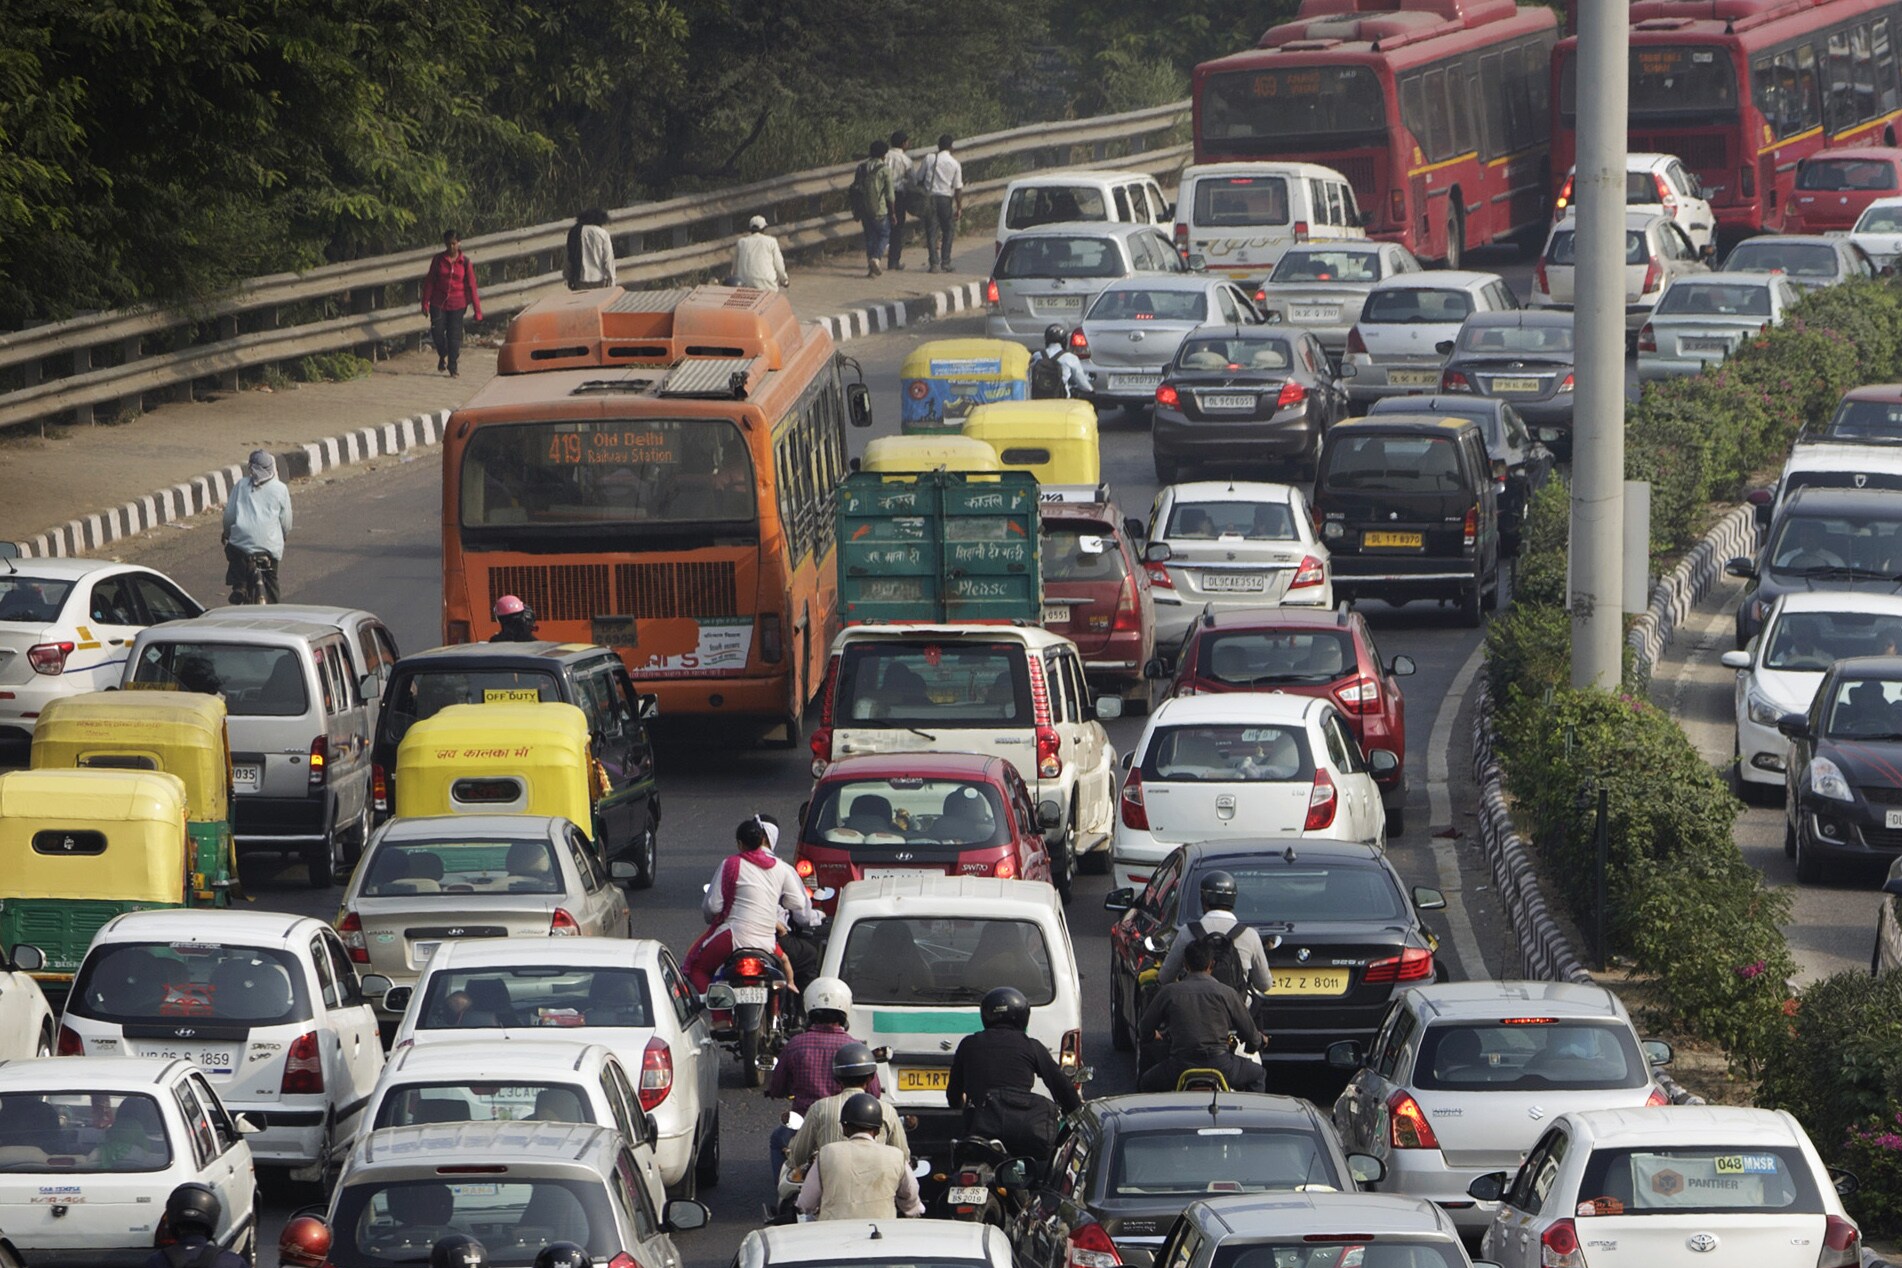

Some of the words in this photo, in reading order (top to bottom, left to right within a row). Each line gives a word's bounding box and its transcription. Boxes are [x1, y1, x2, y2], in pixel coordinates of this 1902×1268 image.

[593, 432, 618, 447] Old
[624, 431, 664, 447] Delhi
[549, 432, 582, 463] 419
[588, 449, 628, 464] Railway
[631, 448, 673, 463] Station
[486, 692, 506, 701] OFF
[508, 692, 536, 701] DUTY
[199, 1053, 229, 1065] 1859
[907, 1072, 922, 1085] DL
[1717, 1157, 1743, 1172] 048
[1744, 1156, 1776, 1171] MNSR
[1688, 1177, 1739, 1190] PANTHER
